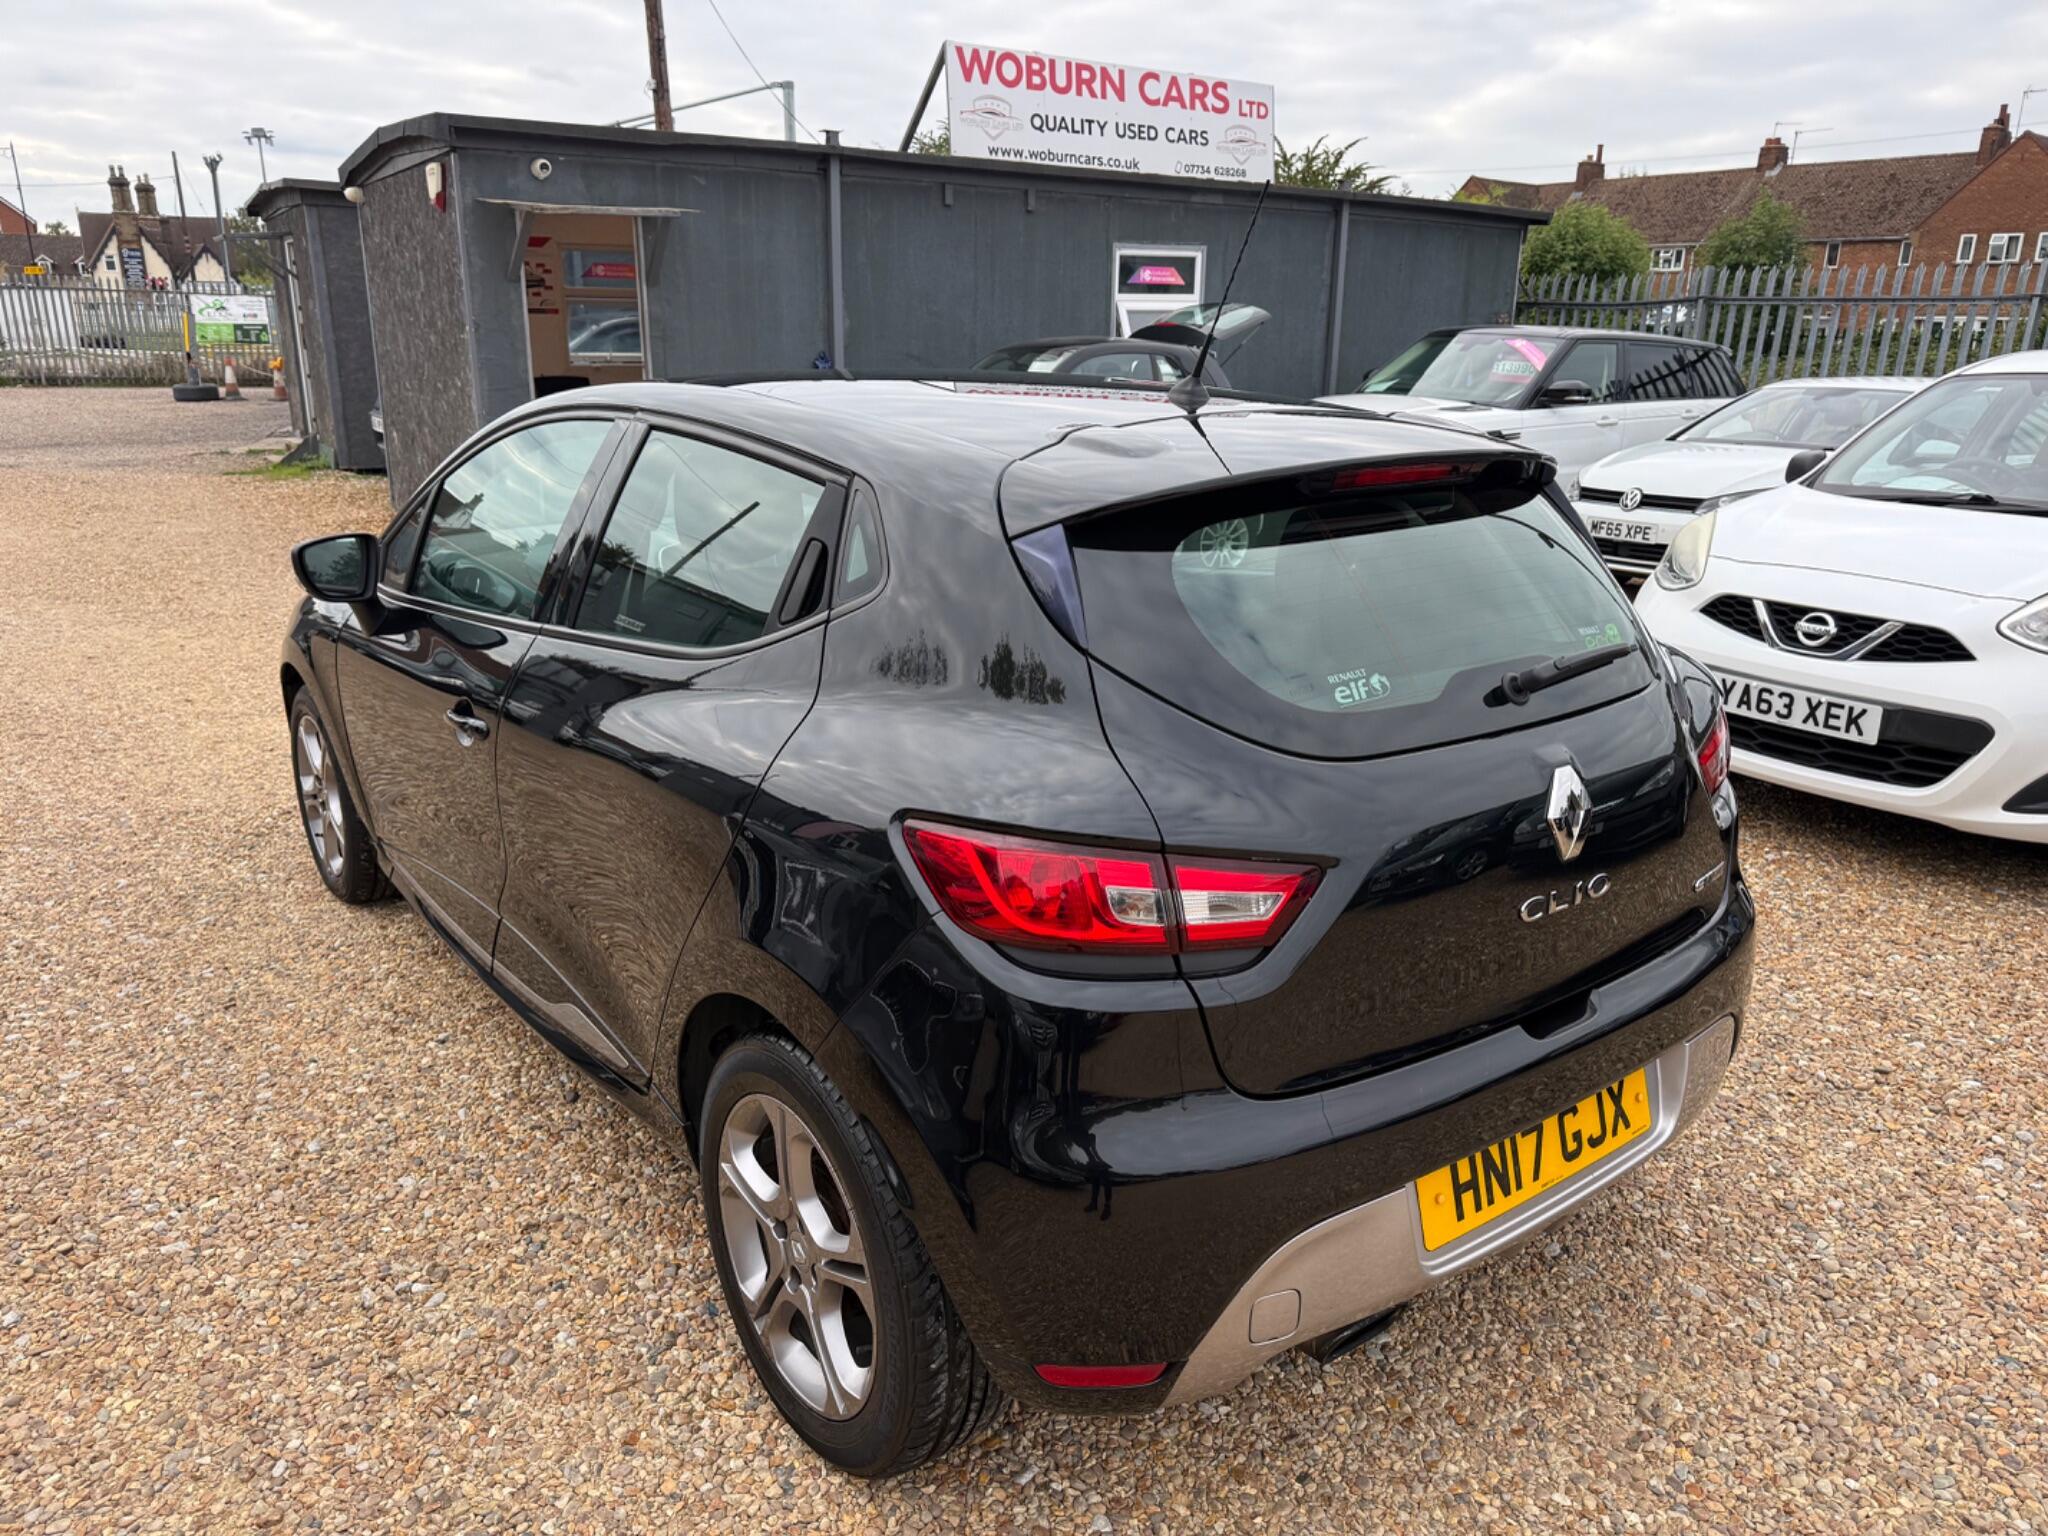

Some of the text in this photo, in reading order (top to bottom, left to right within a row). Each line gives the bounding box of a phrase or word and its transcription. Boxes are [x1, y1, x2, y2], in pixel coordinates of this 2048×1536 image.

[955, 45, 1269, 120] WOBURN CARS LTD
[1030, 113, 1209, 146] QUALITY USED CARS
[988, 145, 1140, 170] www.woburncars.co.uk
[1184, 164, 1247, 178] 07734 628268
[1590, 519, 1652, 542] MF65 XPE
[1327, 668, 1367, 685] RENAULT
[1334, 678, 1369, 704] elf
[1721, 678, 1868, 737] YA63 XEK
[1519, 872, 1612, 923] CLIO
[1450, 1079, 1631, 1222] HN17 GJX
